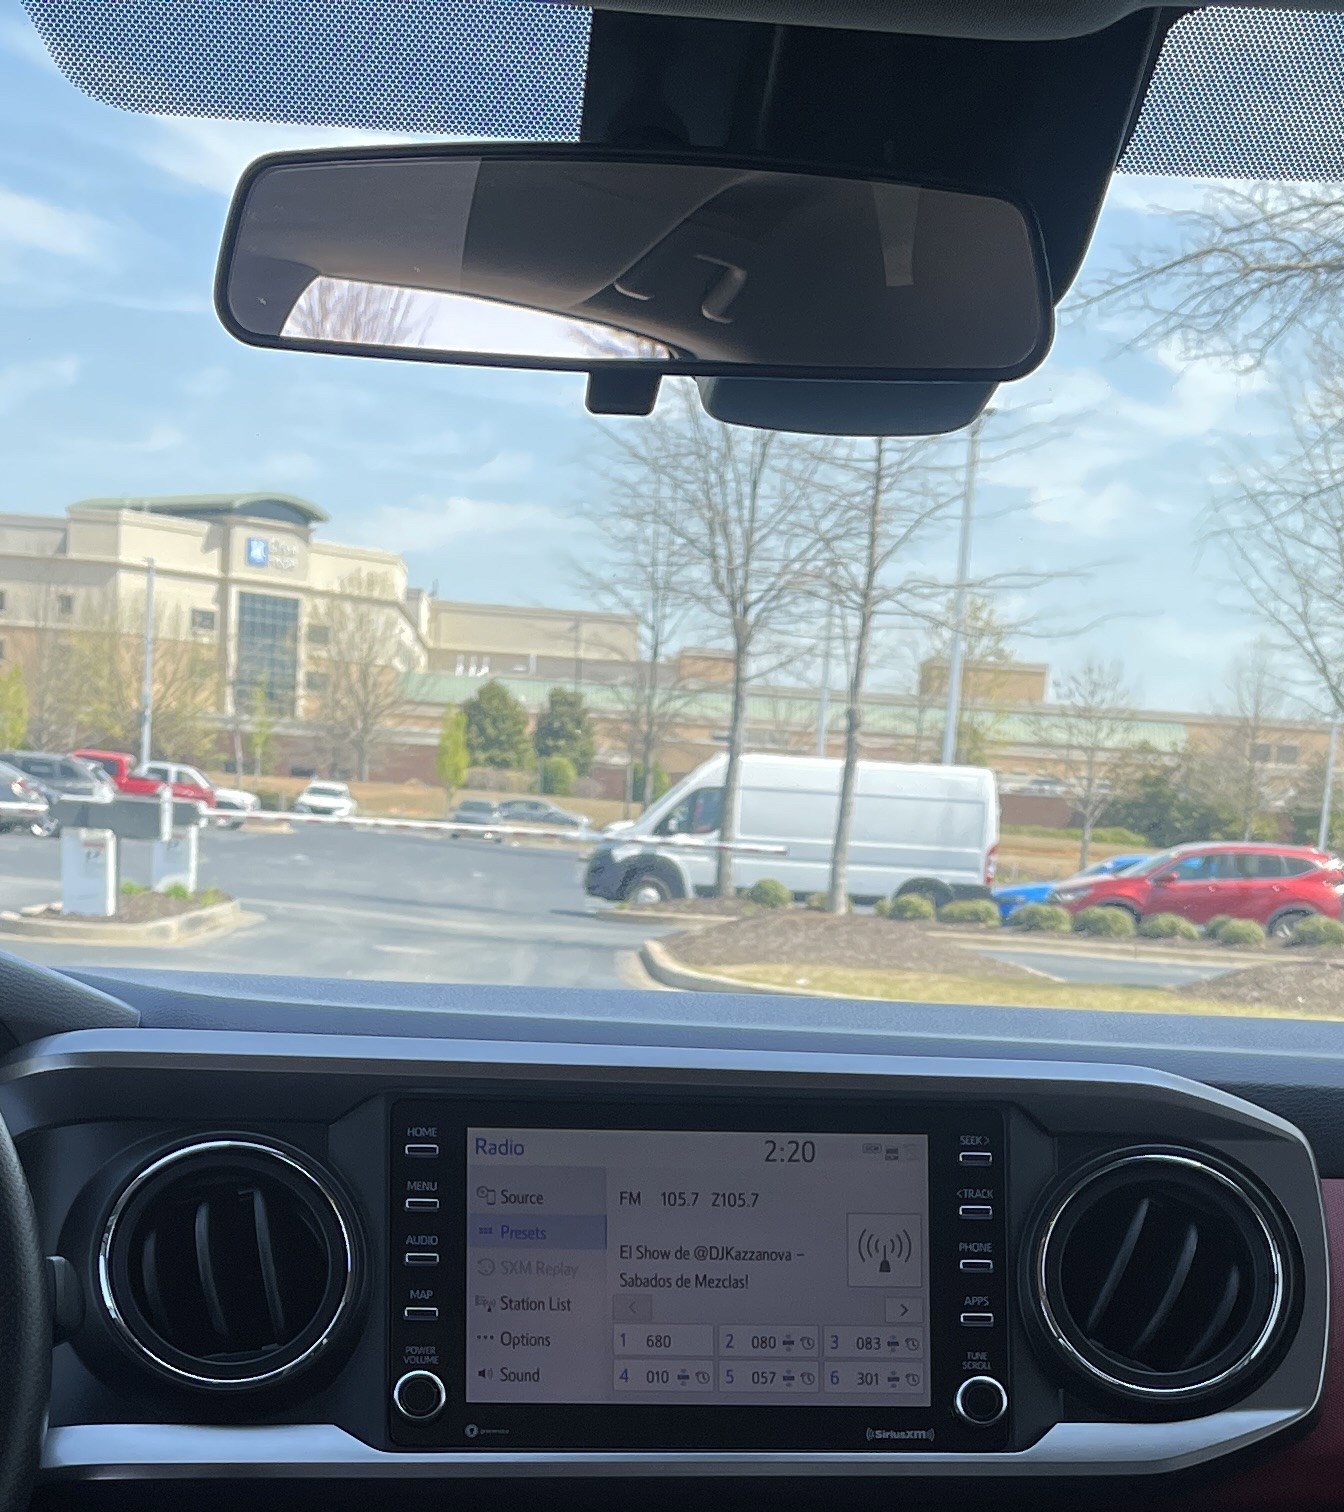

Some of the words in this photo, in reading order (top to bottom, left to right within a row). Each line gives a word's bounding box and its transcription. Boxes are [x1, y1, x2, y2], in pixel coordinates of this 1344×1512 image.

[407, 1127, 438, 1137] HOME
[475, 1138, 525, 1156] Radio
[764, 1140, 816, 1163] 2:20
[406, 1181, 438, 1191] MENU
[500, 1189, 544, 1205] Source
[619, 1191, 642, 1206] FM
[661, 1191, 700, 1206] 105.7
[711, 1192, 760, 1207] Z105.7
[500, 1225, 547, 1240] Presets
[406, 1235, 439, 1246] AUDIO
[958, 1242, 993, 1253] PHONE
[619, 1245, 633, 1259] El
[636, 1245, 671, 1260] Show
[674, 1246, 690, 1260] de
[693, 1246, 792, 1261] @DJKazzanova
[500, 1260, 532, 1275] SXM
[536, 1261, 579, 1279] Replay
[619, 1273, 672, 1288] Sabados
[676, 1274, 691, 1289] de
[694, 1274, 750, 1289] Mezclas!
[409, 1290, 434, 1300] MAP
[963, 1296, 990, 1307] APPS
[500, 1295, 546, 1311] Station
[549, 1297, 572, 1311] List
[500, 1331, 551, 1349] Options
[646, 1335, 672, 1348] 680
[725, 1333, 735, 1349] 2
[751, 1336, 777, 1349] 080
[830, 1334, 839, 1350] 3
[856, 1337, 882, 1350] 083
[405, 1346, 436, 1355] POWER
[966, 1351, 989, 1360] TUNE
[403, 1355, 440, 1365] VOLUME
[961, 1360, 992, 1370] SCROLL
[500, 1367, 540, 1382] Sound
[619, 1368, 630, 1383] 4
[646, 1370, 670, 1384] 010
[725, 1369, 735, 1384] 5
[751, 1371, 777, 1384] 057
[830, 1370, 840, 1385] 6
[856, 1372, 879, 1386] 301
